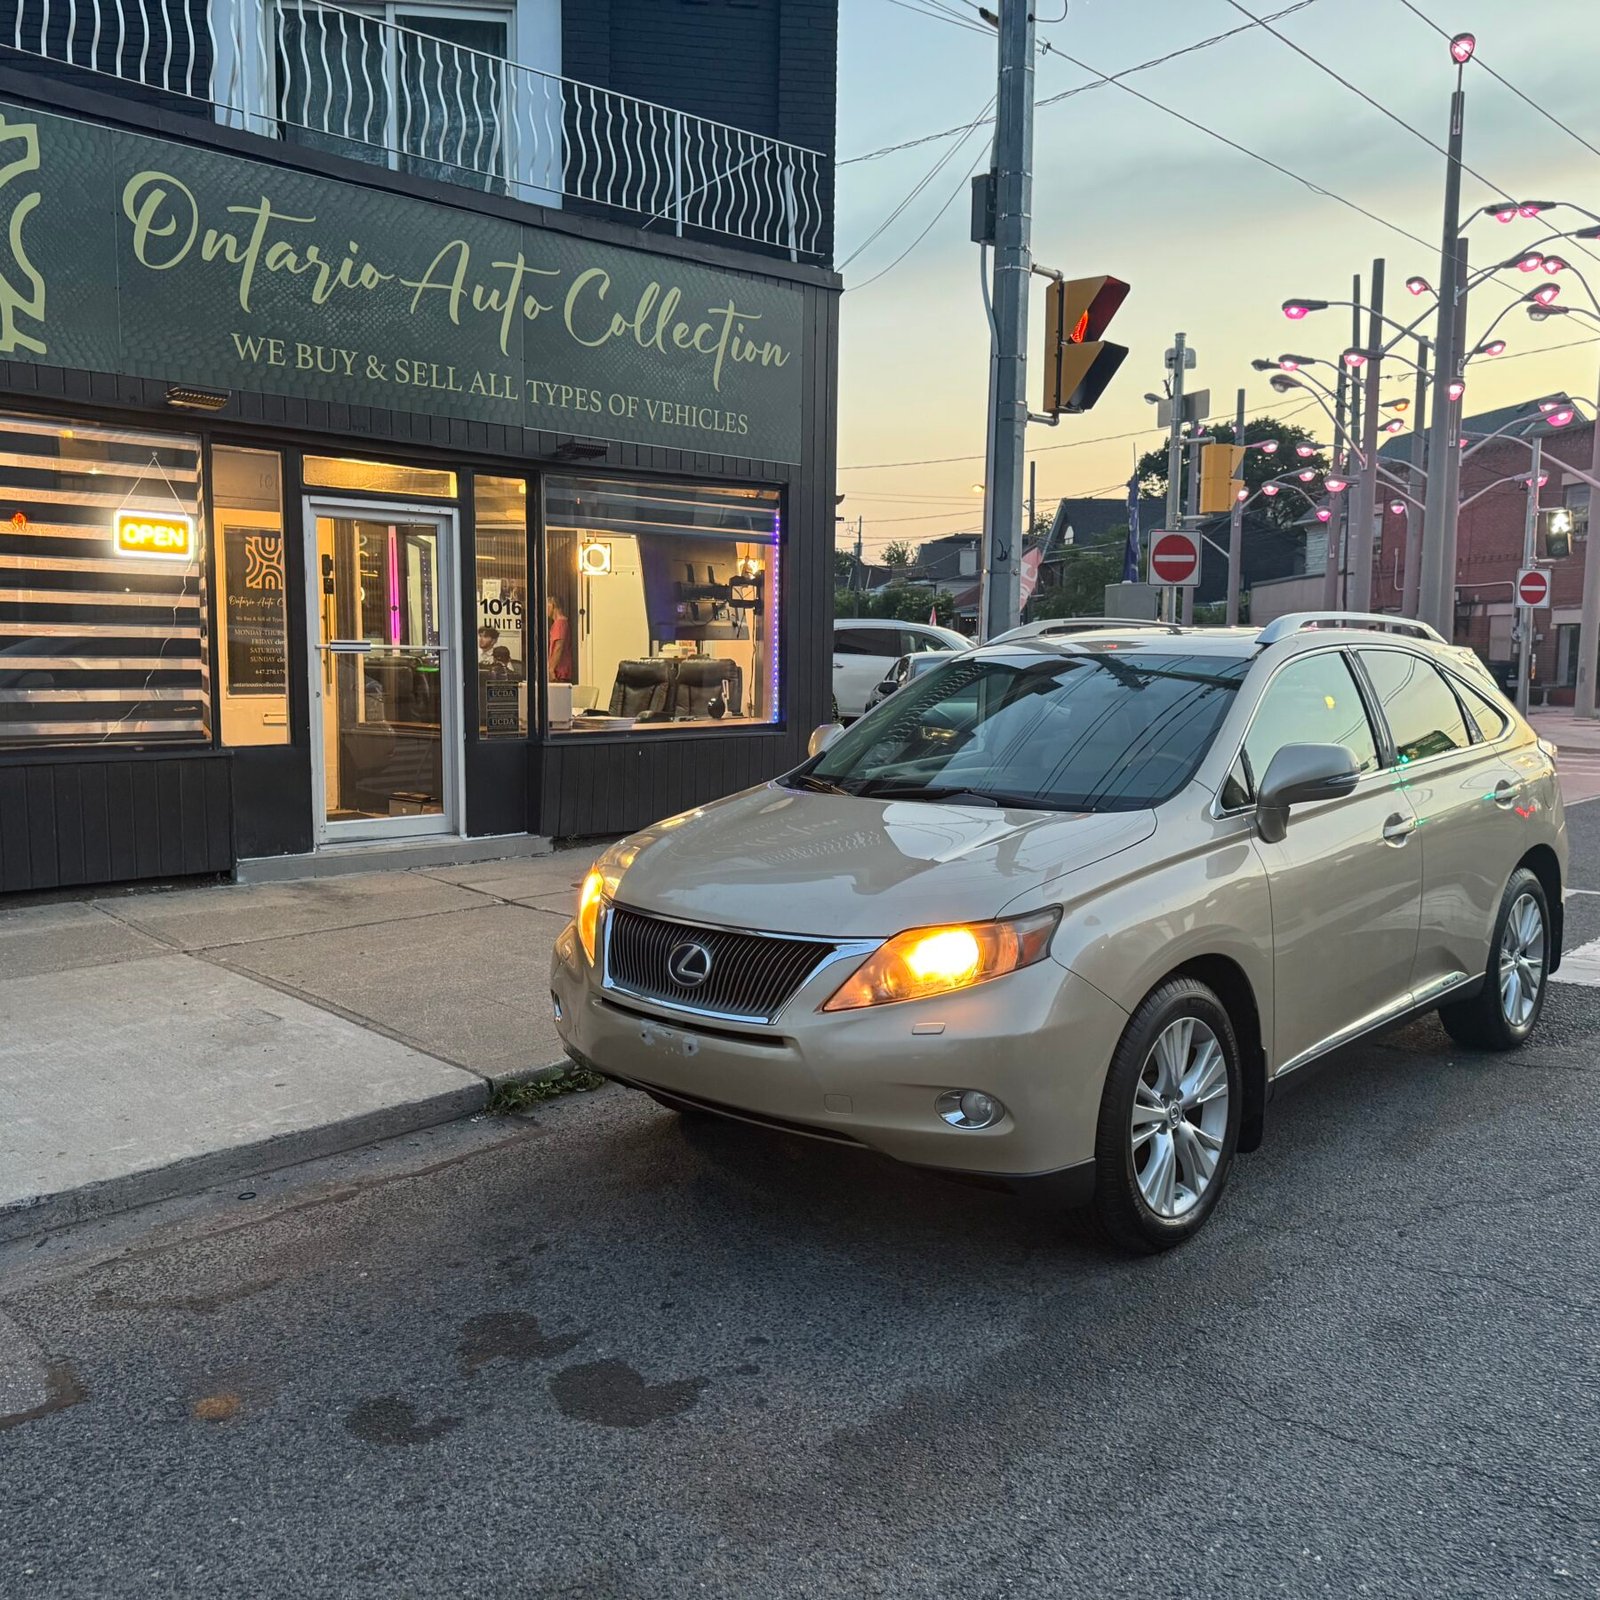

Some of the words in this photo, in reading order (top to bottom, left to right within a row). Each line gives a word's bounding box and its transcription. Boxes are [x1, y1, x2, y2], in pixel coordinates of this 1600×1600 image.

[122, 171, 392, 313] Ontario
[400, 239, 559, 355] Auto
[563, 267, 792, 391] Collection
[231, 332, 287, 367] WE
[295, 343, 357, 378] BUY
[366, 355, 388, 381] &
[395, 358, 463, 392] SELL
[469, 370, 519, 400] ALL
[526, 379, 603, 412] TYPES
[608, 393, 640, 418] OF
[645, 400, 749, 435] VEHICLES
[122, 523, 185, 547] OPEN
[480, 599, 522, 615] 1016
[484, 618, 513, 628] UNIT
[515, 619, 522, 629] B
[491, 690, 514, 698] UCDA
[491, 718, 515, 726] UCDA
